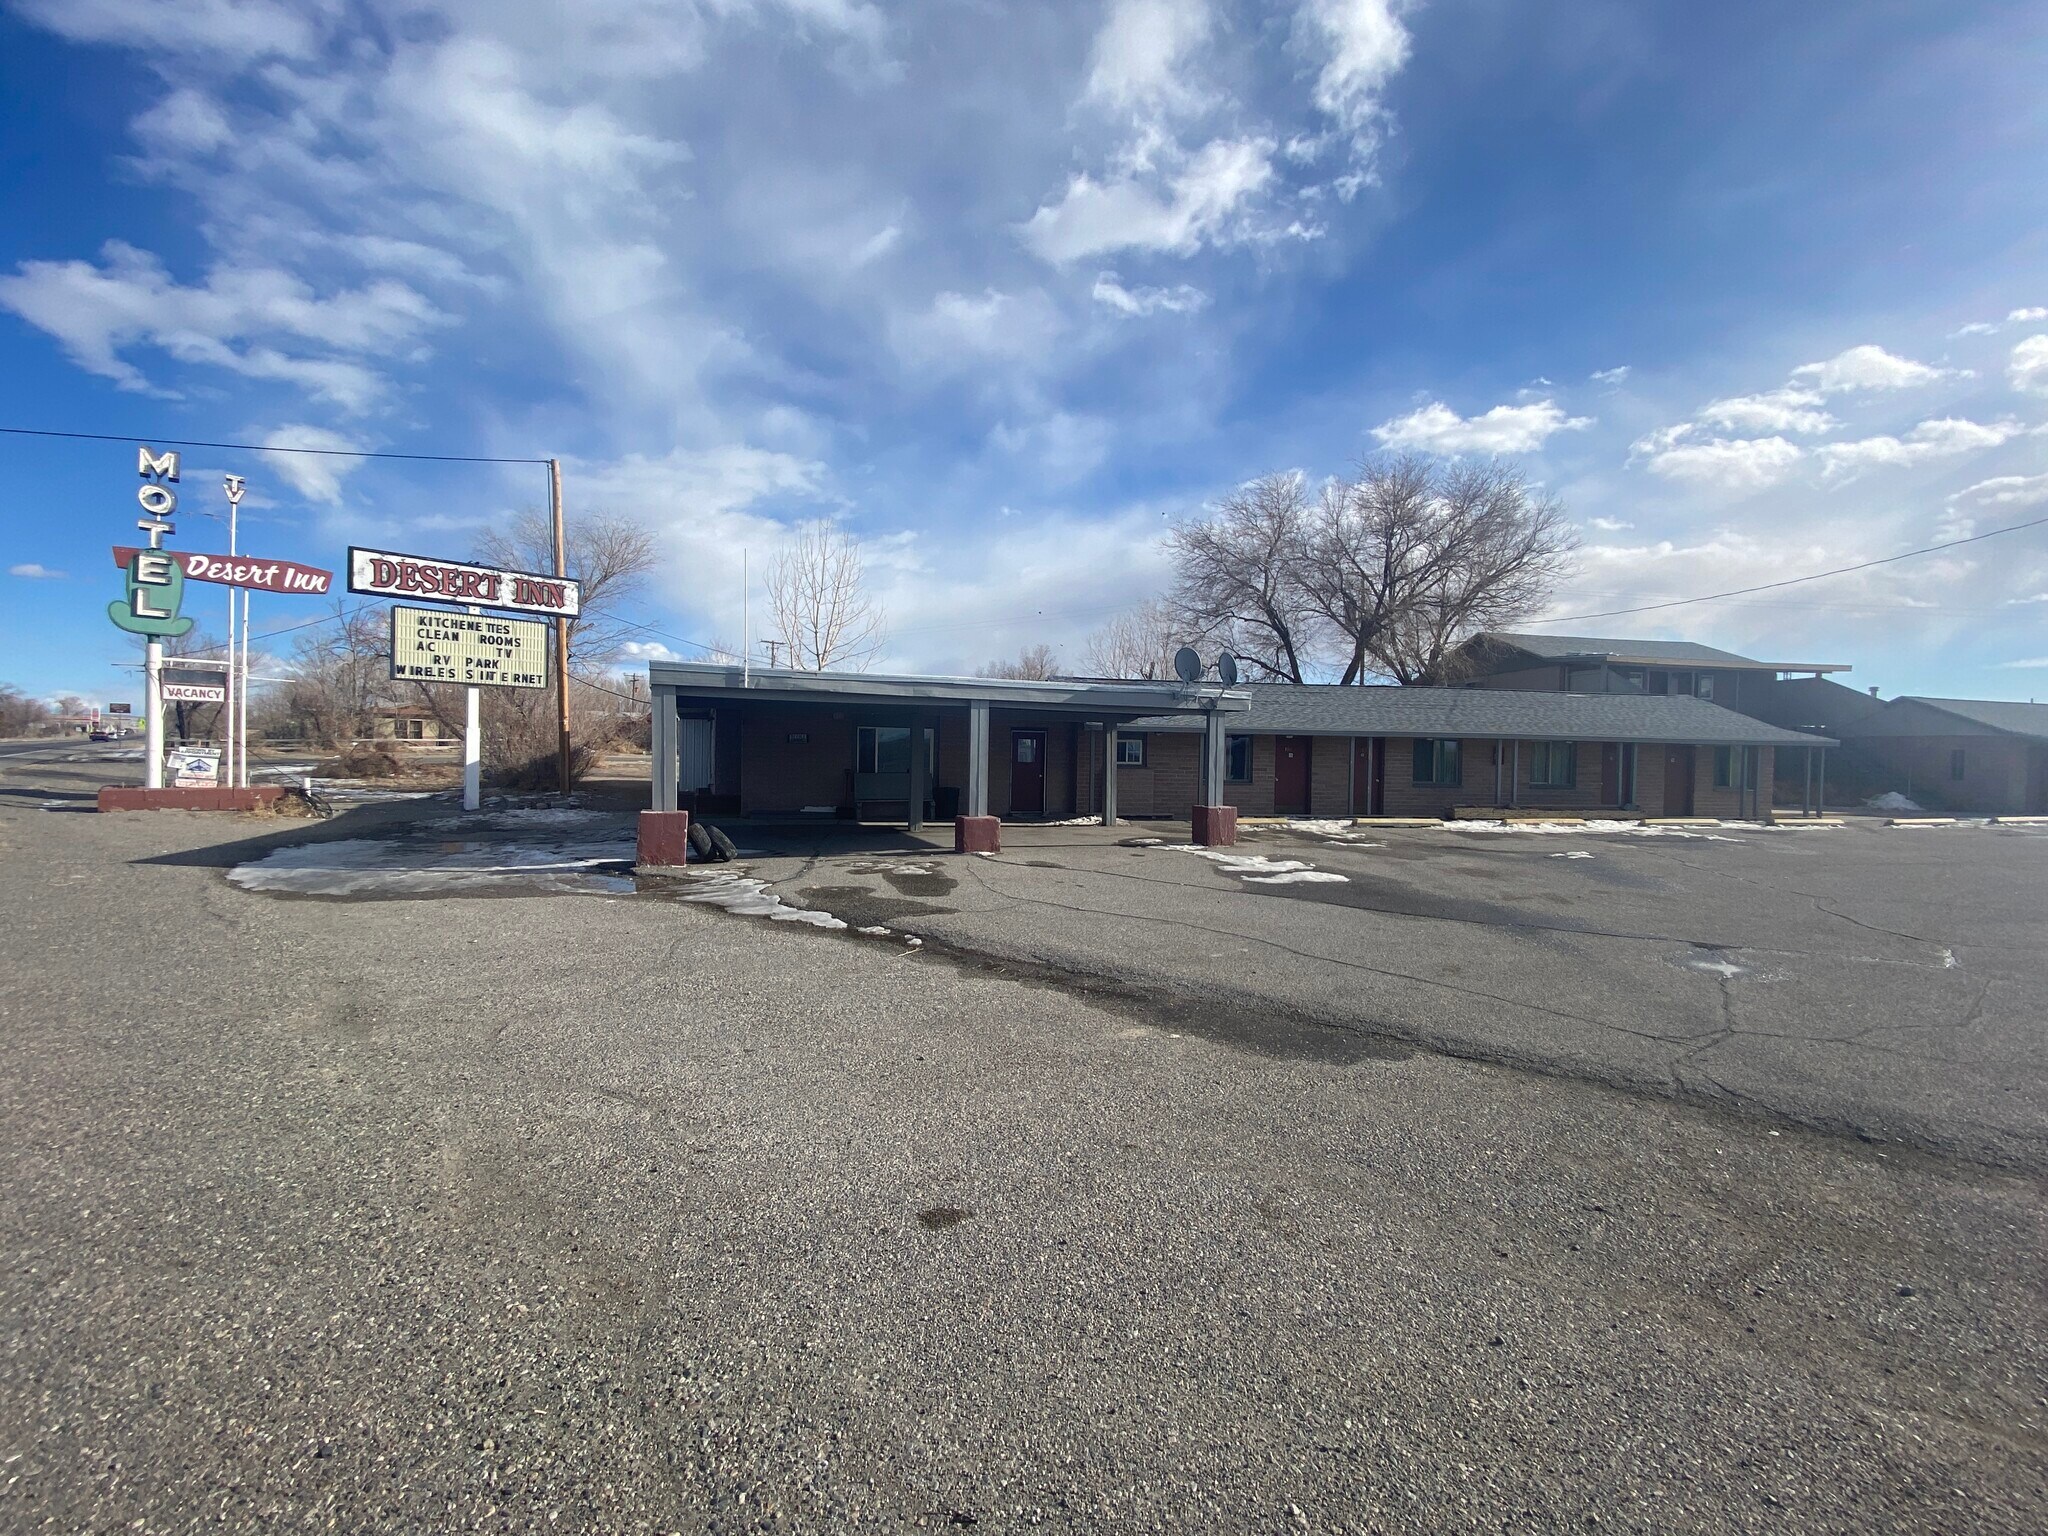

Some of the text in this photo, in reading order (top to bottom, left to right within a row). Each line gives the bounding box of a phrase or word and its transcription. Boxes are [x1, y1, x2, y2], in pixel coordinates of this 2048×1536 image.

[134, 446, 180, 617] MOTEL
[187, 555, 329, 592] Desert Inn
[370, 558, 567, 609] DESERT INN
[418, 616, 510, 635] KITCHENETTES
[417, 628, 521, 648] CLEAN ROOMS
[416, 641, 513, 659] AC TV
[433, 655, 500, 670] RV PARK
[168, 688, 221, 699] VACANCY
